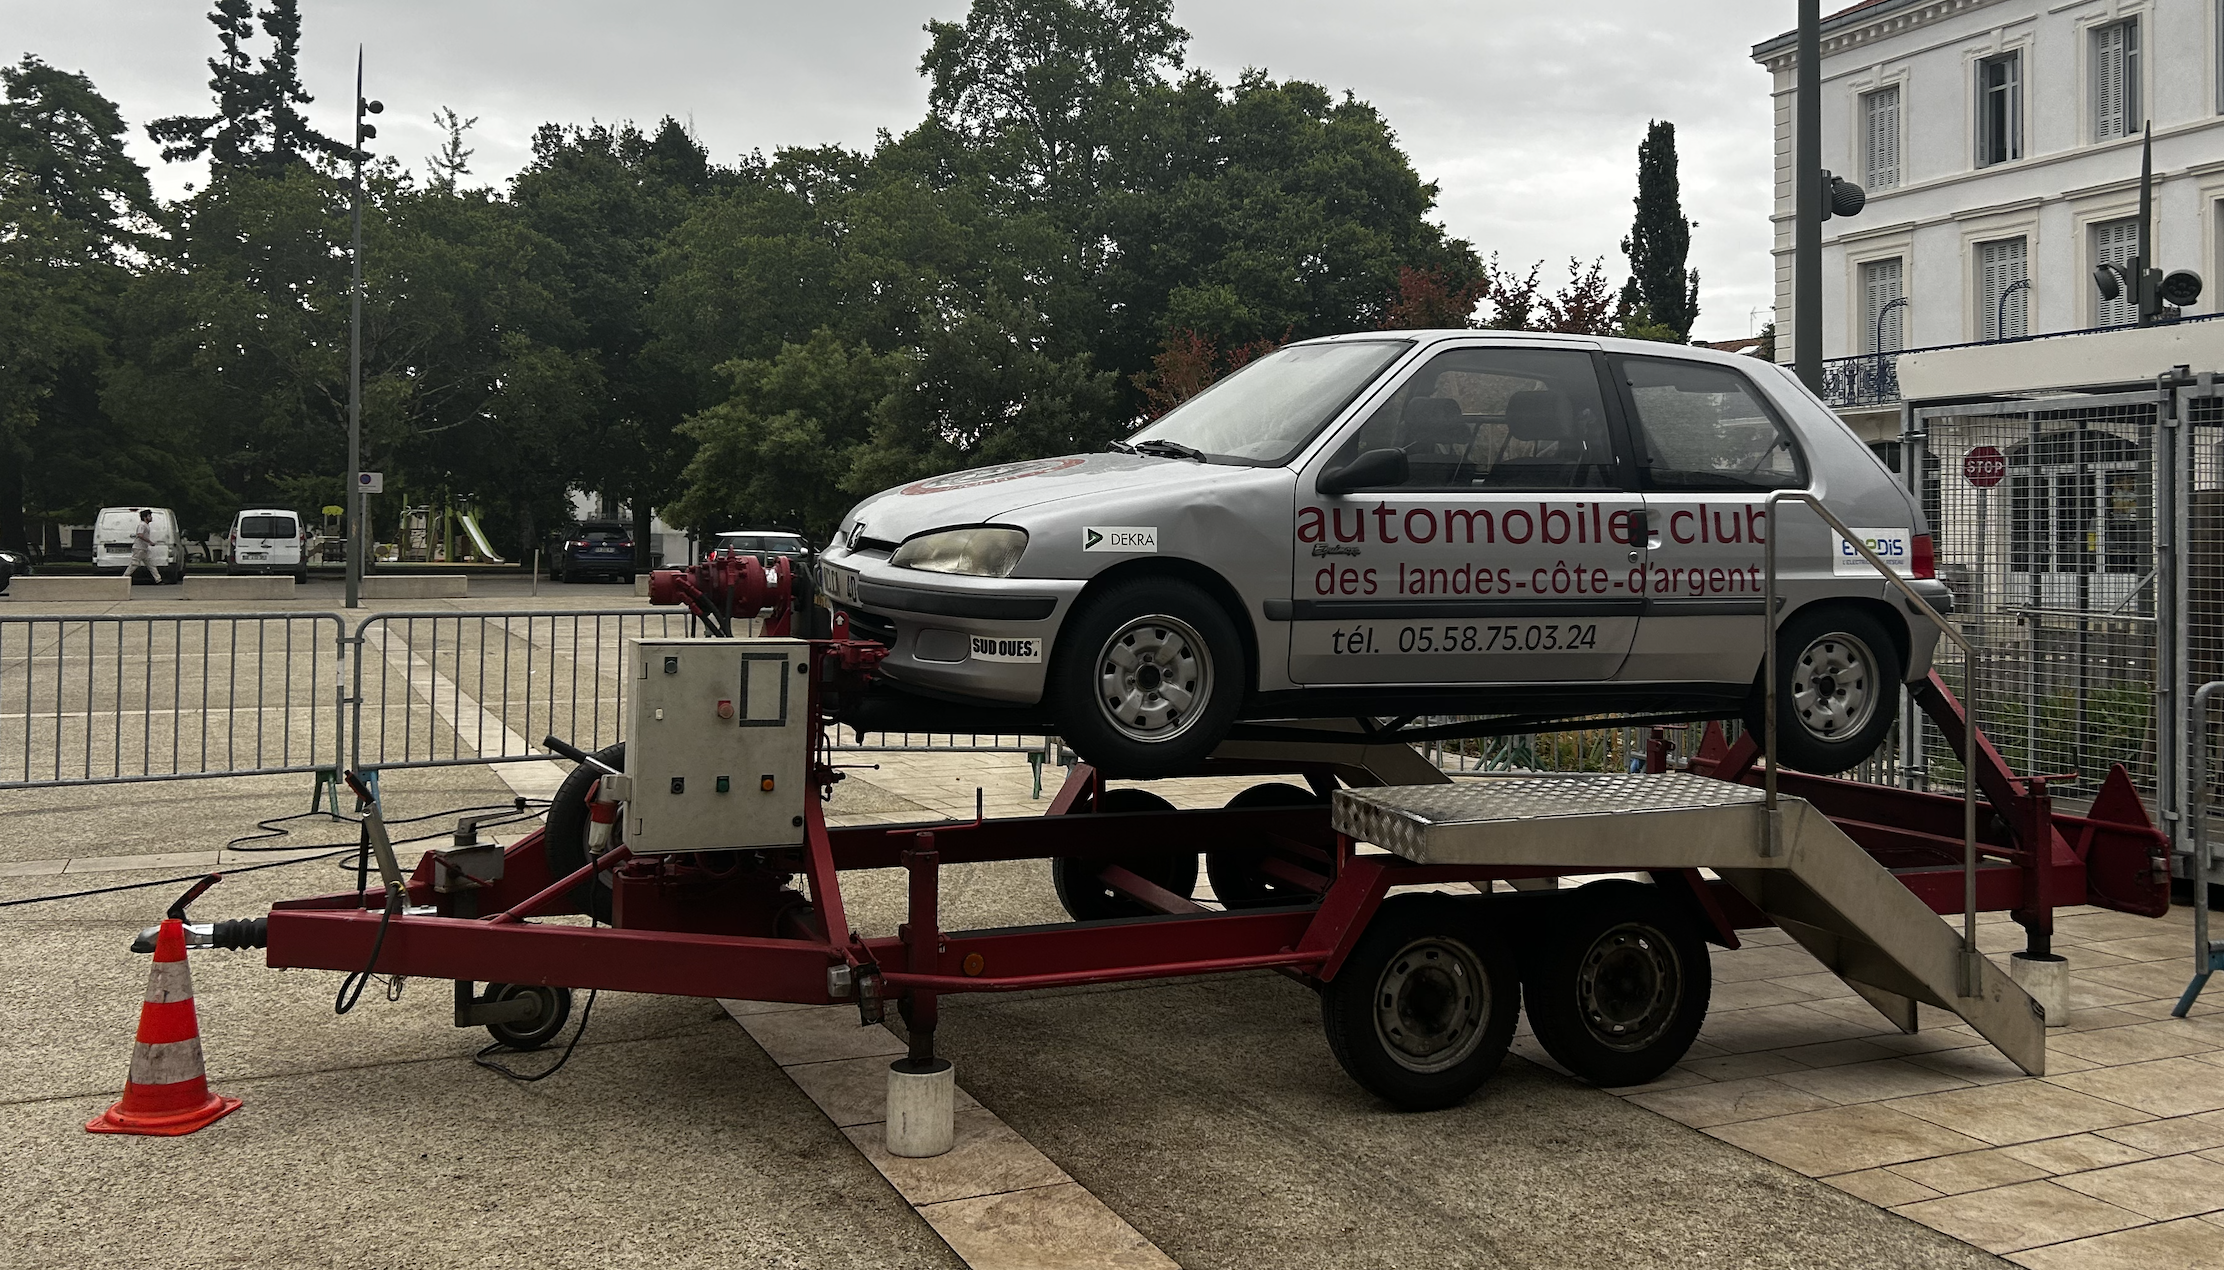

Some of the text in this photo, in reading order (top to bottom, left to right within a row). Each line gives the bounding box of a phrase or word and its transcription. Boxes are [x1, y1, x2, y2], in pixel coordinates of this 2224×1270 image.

[1966, 460, 2003, 474] STOP
[1111, 533, 1155, 546] DEKRA
[1314, 560, 1761, 596] des landes-côte-d'argent
[973, 638, 1038, 657] SUD OUES
[1332, 624, 1597, 655] tél. 05.58.75.03.24
